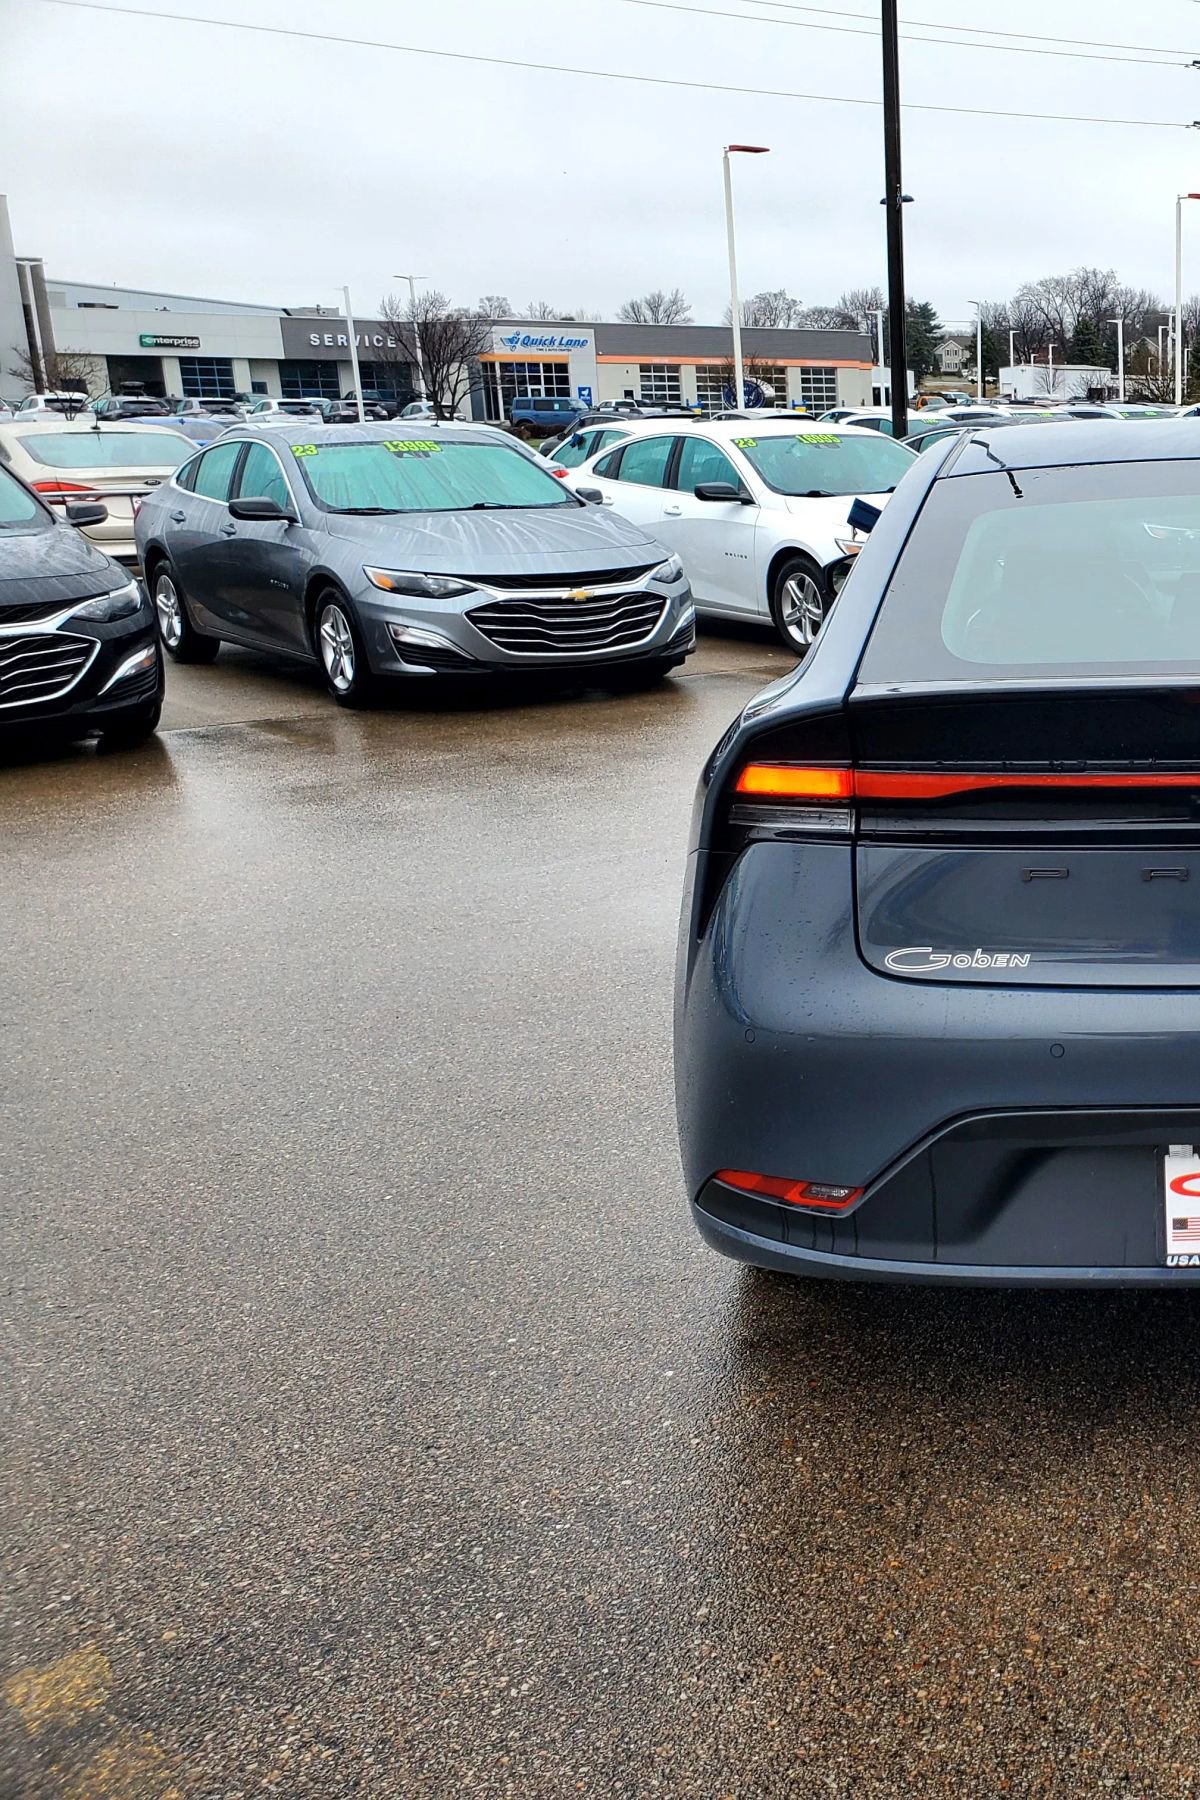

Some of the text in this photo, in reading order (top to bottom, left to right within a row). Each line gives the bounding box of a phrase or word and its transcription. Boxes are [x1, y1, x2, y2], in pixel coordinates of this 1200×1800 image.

[142, 336, 199, 346] enterprise
[309, 333, 398, 348] SERVICE
[520, 335, 589, 348] Quick Lane
[291, 440, 442, 456] 23 13995
[735, 438, 756, 448] 23
[1166, 1254, 1200, 1266] USA
